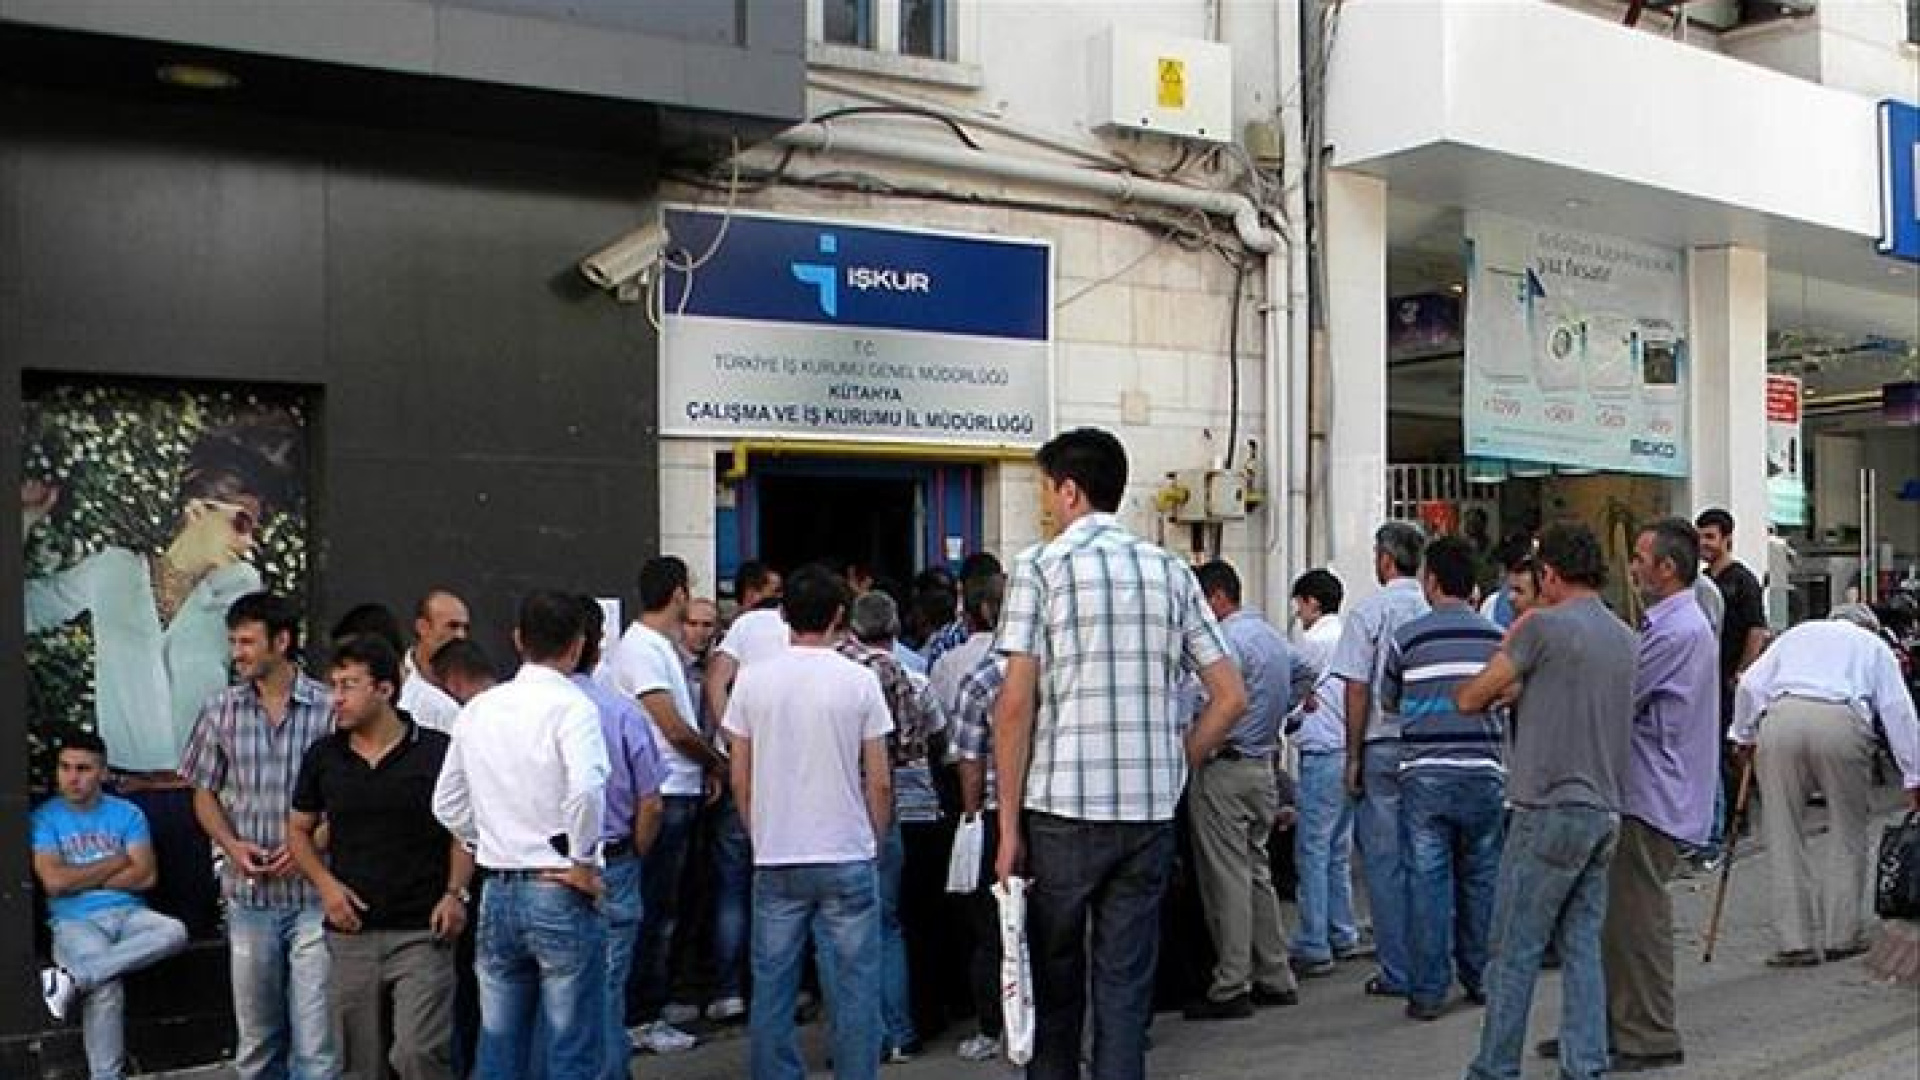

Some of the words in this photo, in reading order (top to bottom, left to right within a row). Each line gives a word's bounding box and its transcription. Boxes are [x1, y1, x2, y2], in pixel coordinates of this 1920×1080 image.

[801, 360, 863, 379] KURUMU
[829, 383, 902, 402] KÜTAHYA
[686, 402, 771, 425] ÇALIŞMA
[773, 405, 799, 423] VE
[825, 407, 902, 427] KURUMU
[905, 408, 922, 428] İL
[926, 411, 1034, 434] MÜDÜRLÜĞÜ
